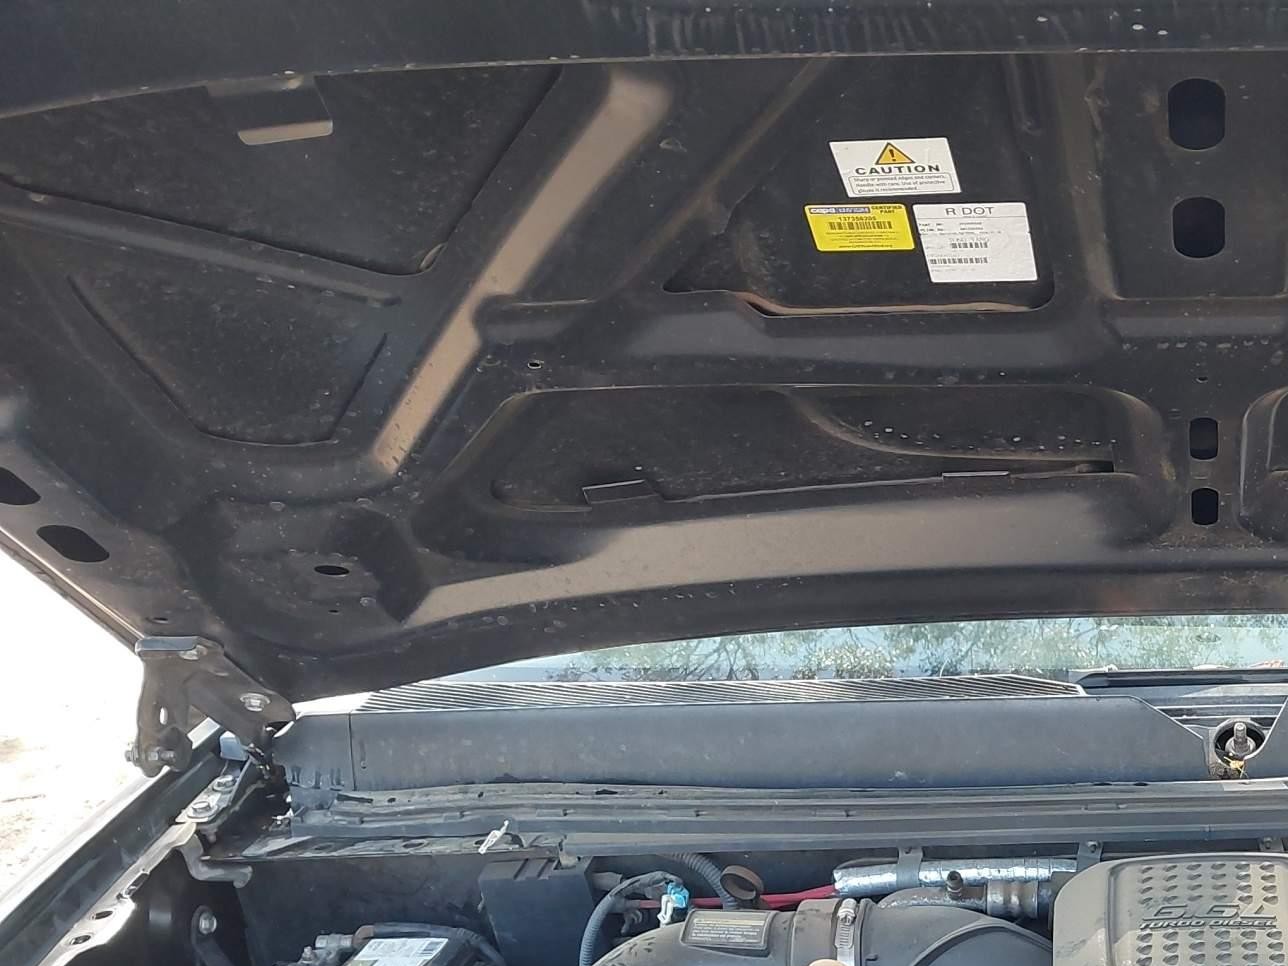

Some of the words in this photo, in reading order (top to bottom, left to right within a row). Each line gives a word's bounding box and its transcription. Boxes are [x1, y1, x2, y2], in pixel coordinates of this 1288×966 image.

[855, 164, 941, 175] CAUTION
[961, 206, 995, 215] DOT
[1140, 919, 1206, 931] TURBO
[1208, 919, 1277, 930] DIESEL
